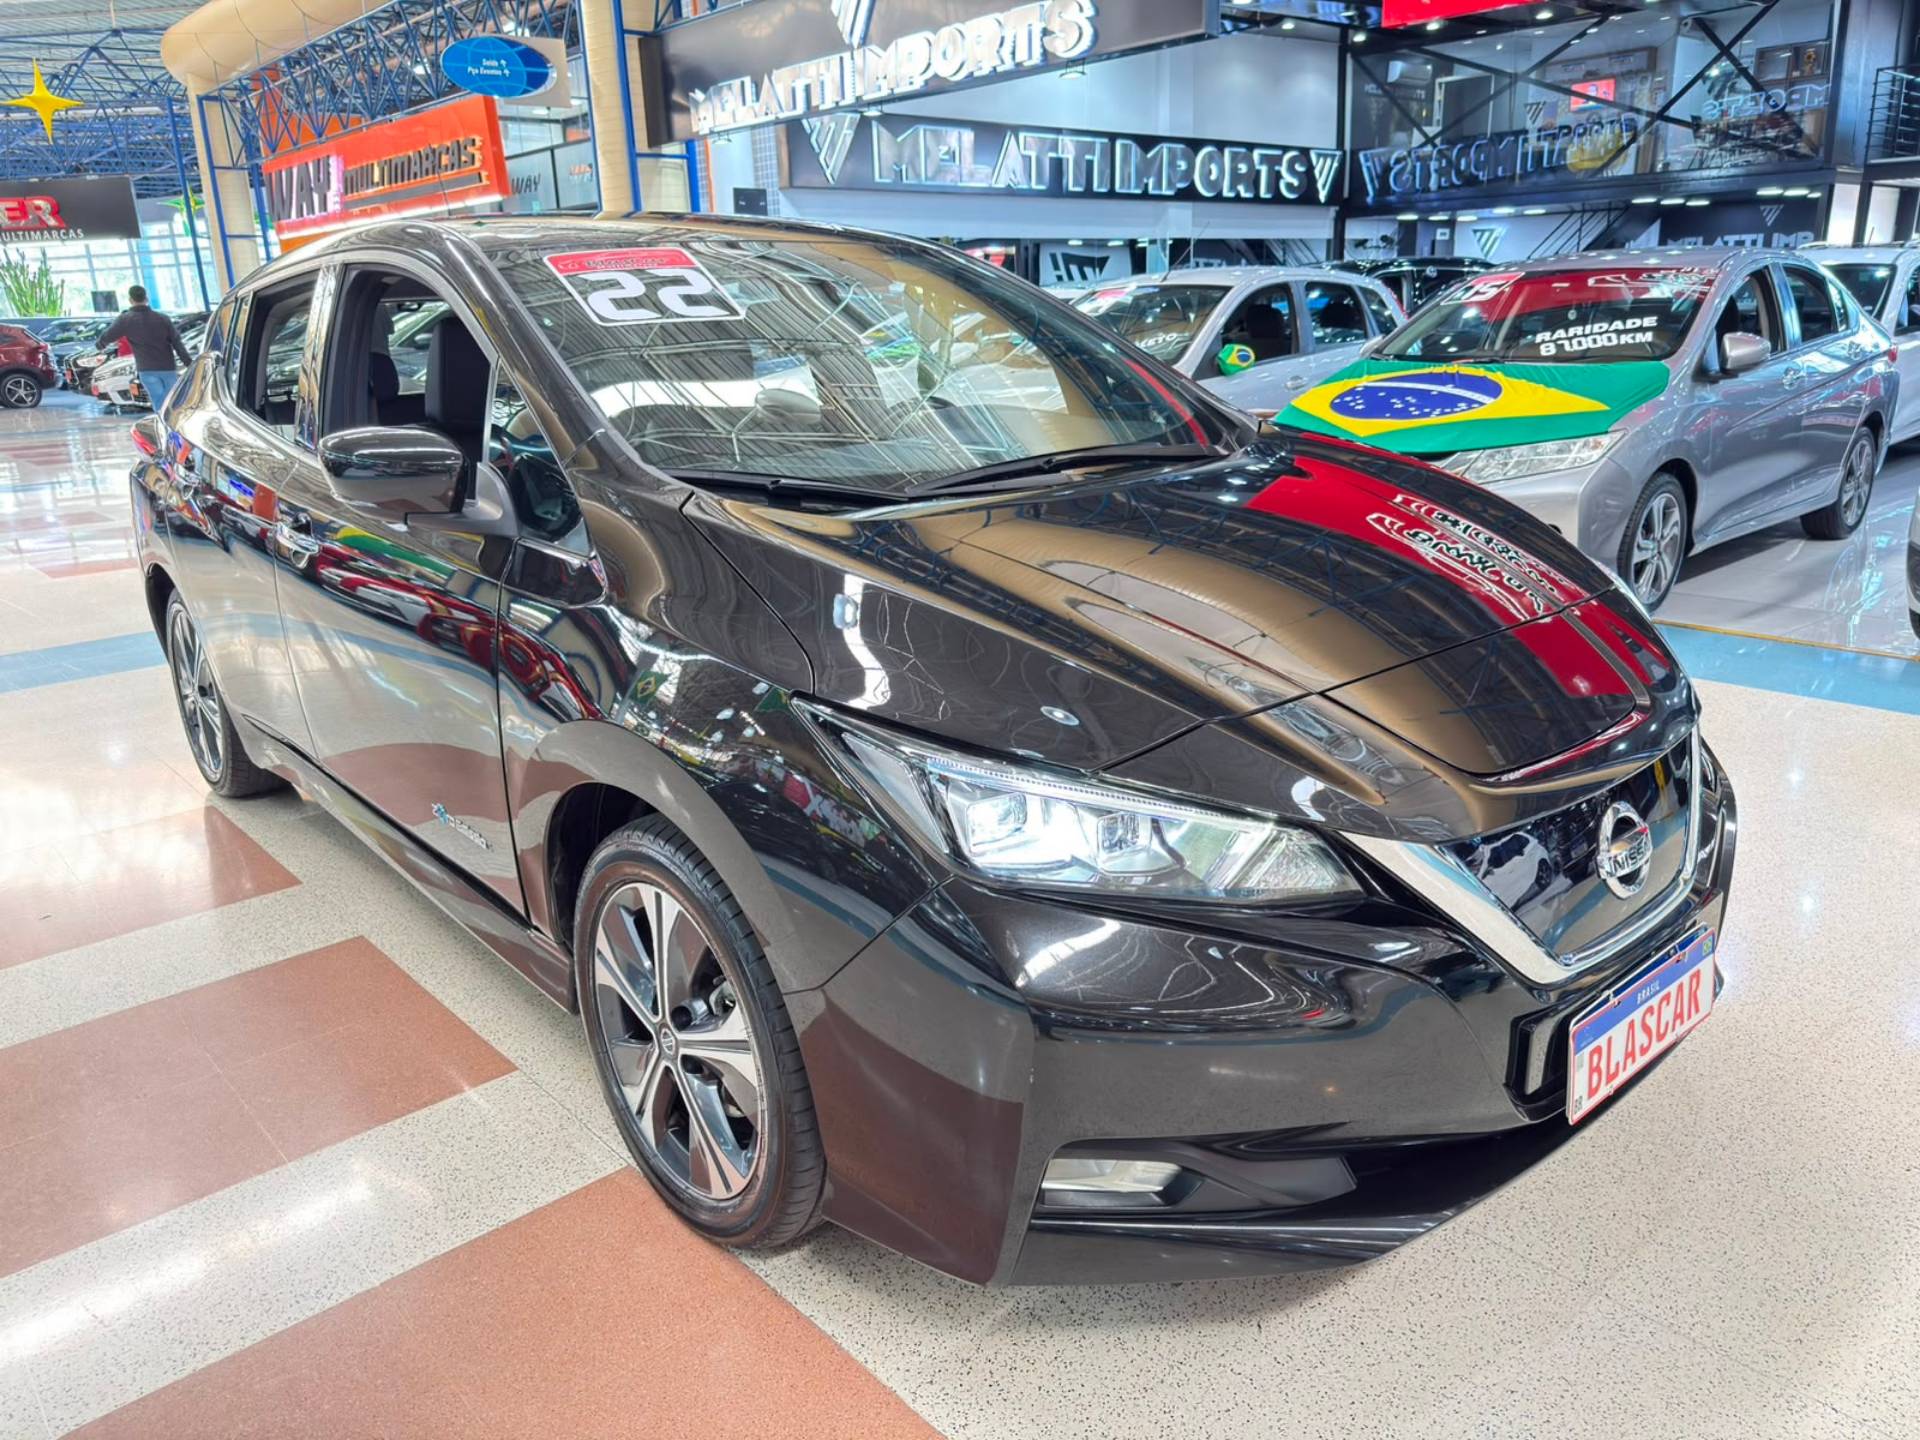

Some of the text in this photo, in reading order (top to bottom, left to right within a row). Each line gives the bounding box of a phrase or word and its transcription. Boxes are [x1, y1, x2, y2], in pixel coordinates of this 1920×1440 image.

[688, 0, 1099, 135] MELATTI IMPORTS
[264, 154, 341, 222] WAY
[510, 174, 541, 194] WAY
[872, 119, 1308, 199] MELATTI IMPORTS
[0, 228, 85, 241] ULTIMARCAS
[578, 268, 732, 320] 22
[1535, 316, 1658, 343] RARIDADE
[1587, 968, 1701, 1099] BLASCAR
